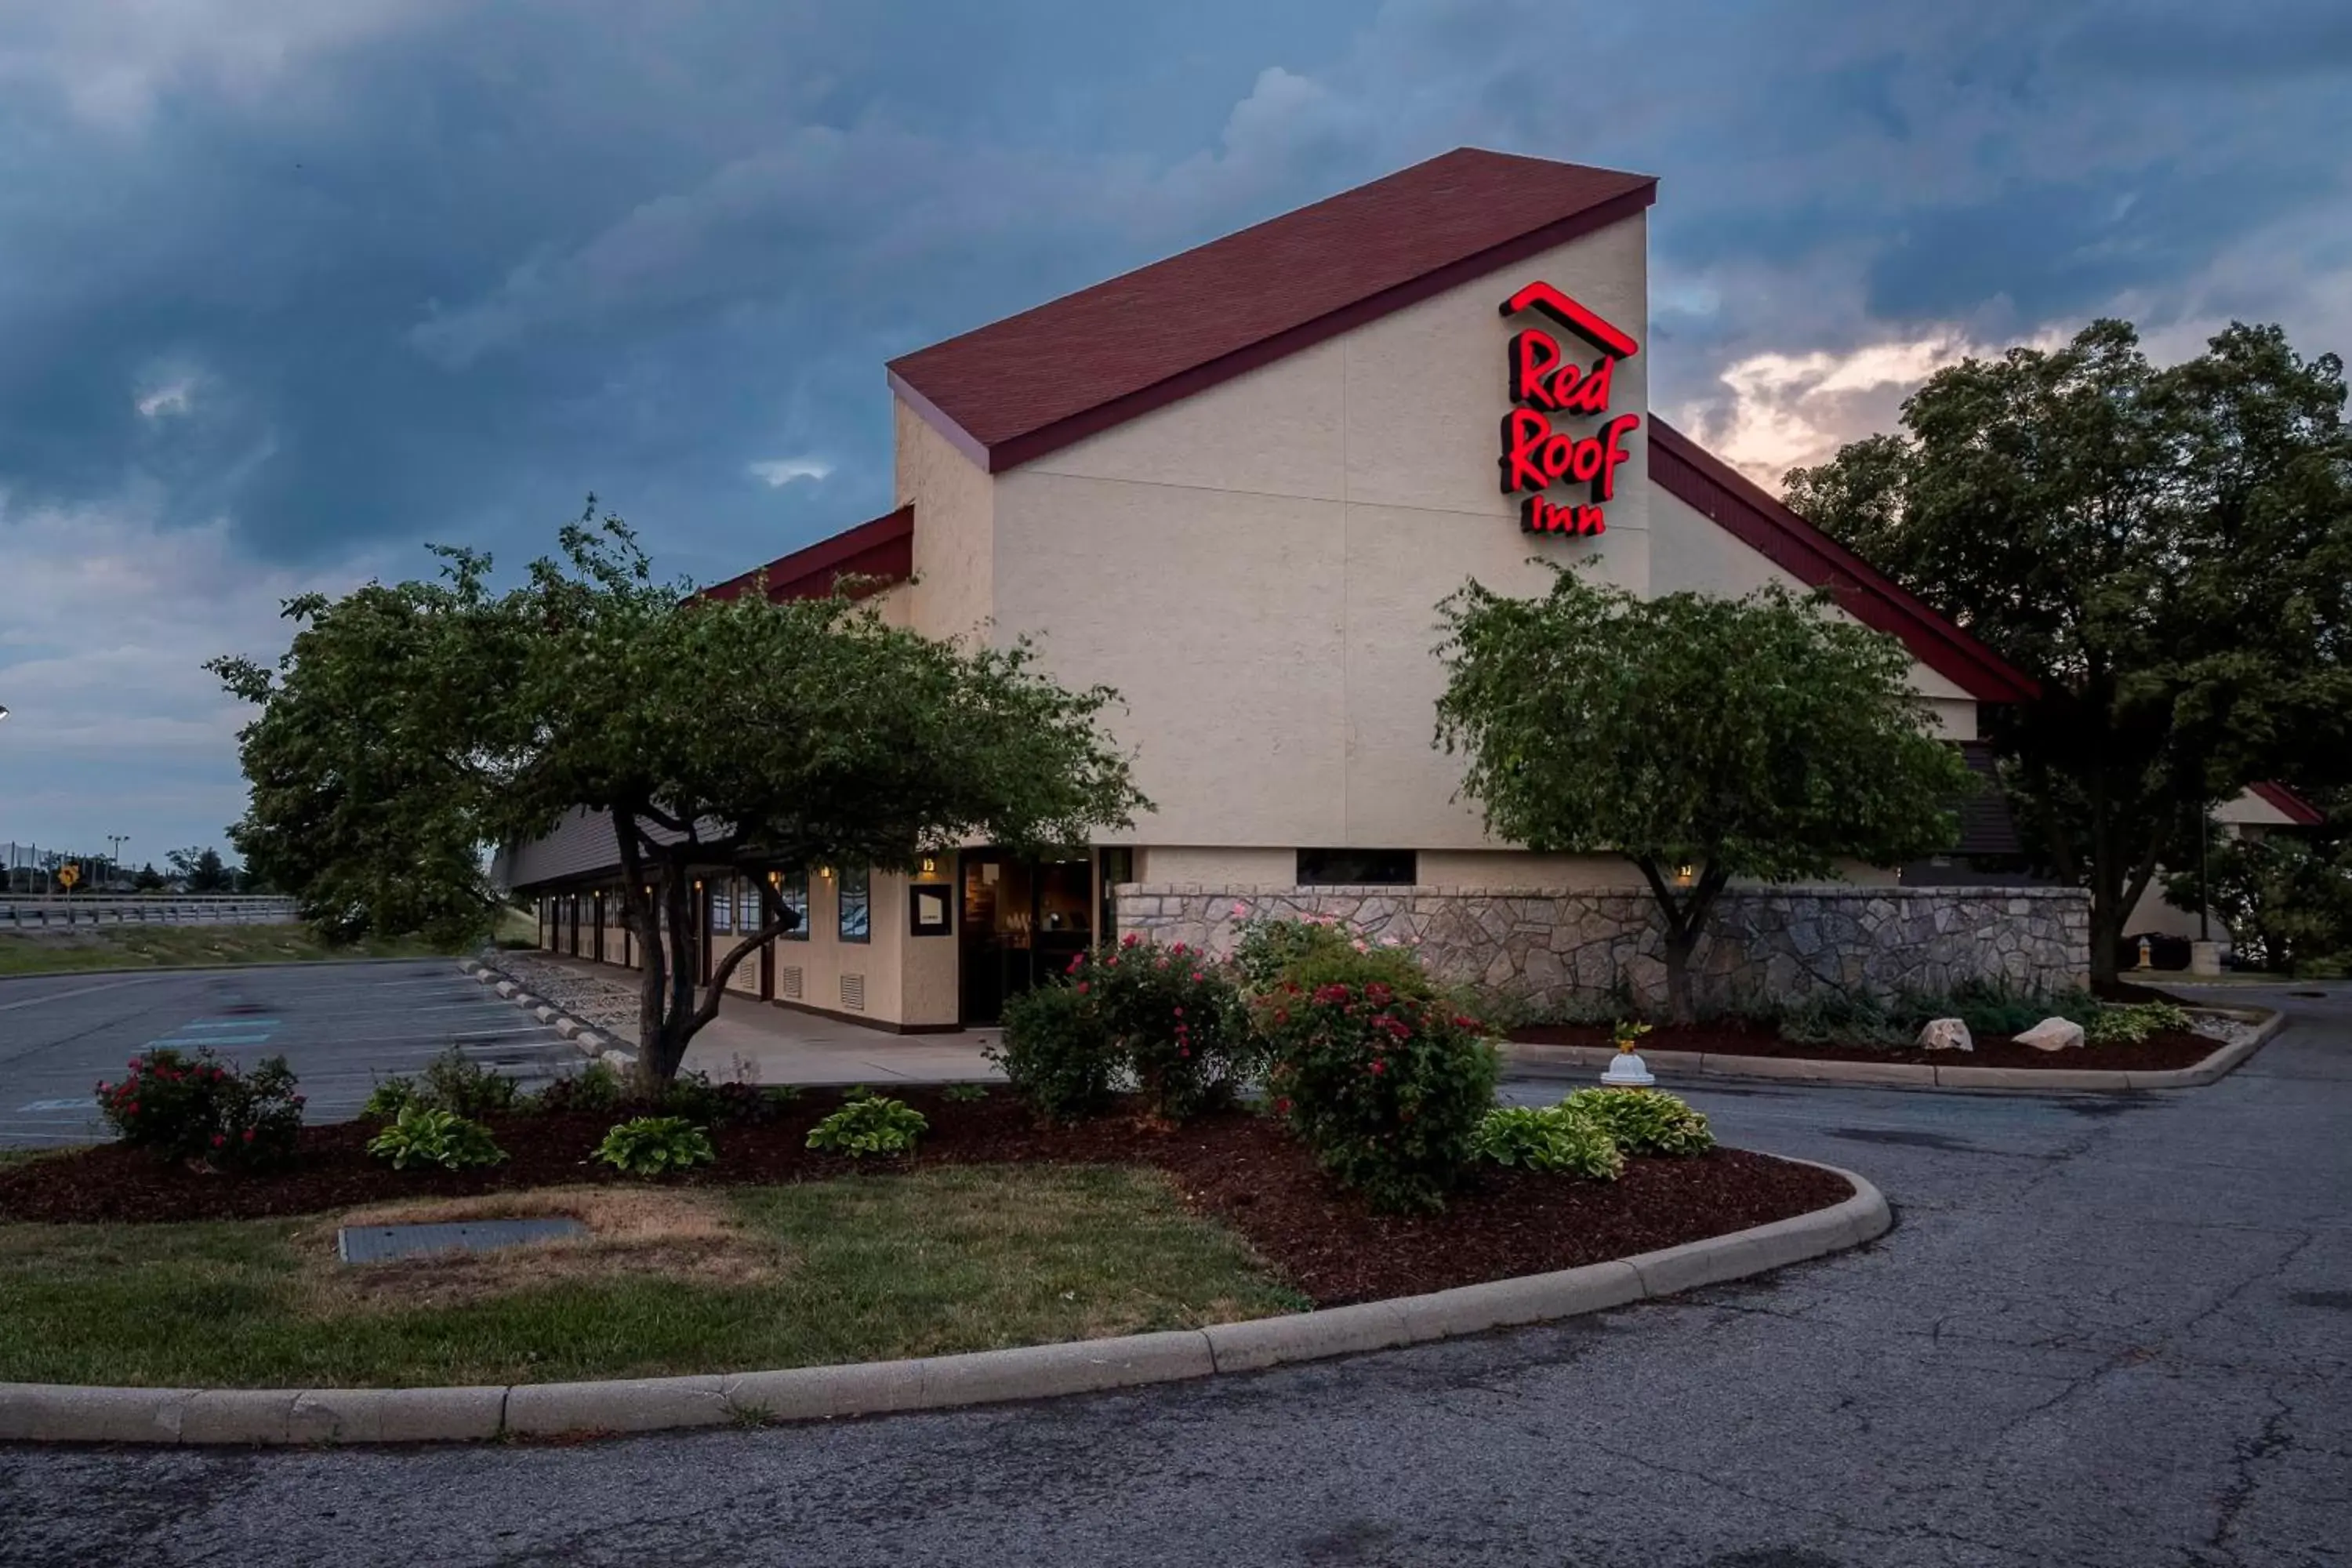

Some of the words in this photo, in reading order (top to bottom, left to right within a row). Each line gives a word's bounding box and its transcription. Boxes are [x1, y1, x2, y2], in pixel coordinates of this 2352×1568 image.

[1519, 328, 1615, 412] Red
[1508, 407, 1641, 501] Roof
[1531, 494, 1606, 535] Inn
